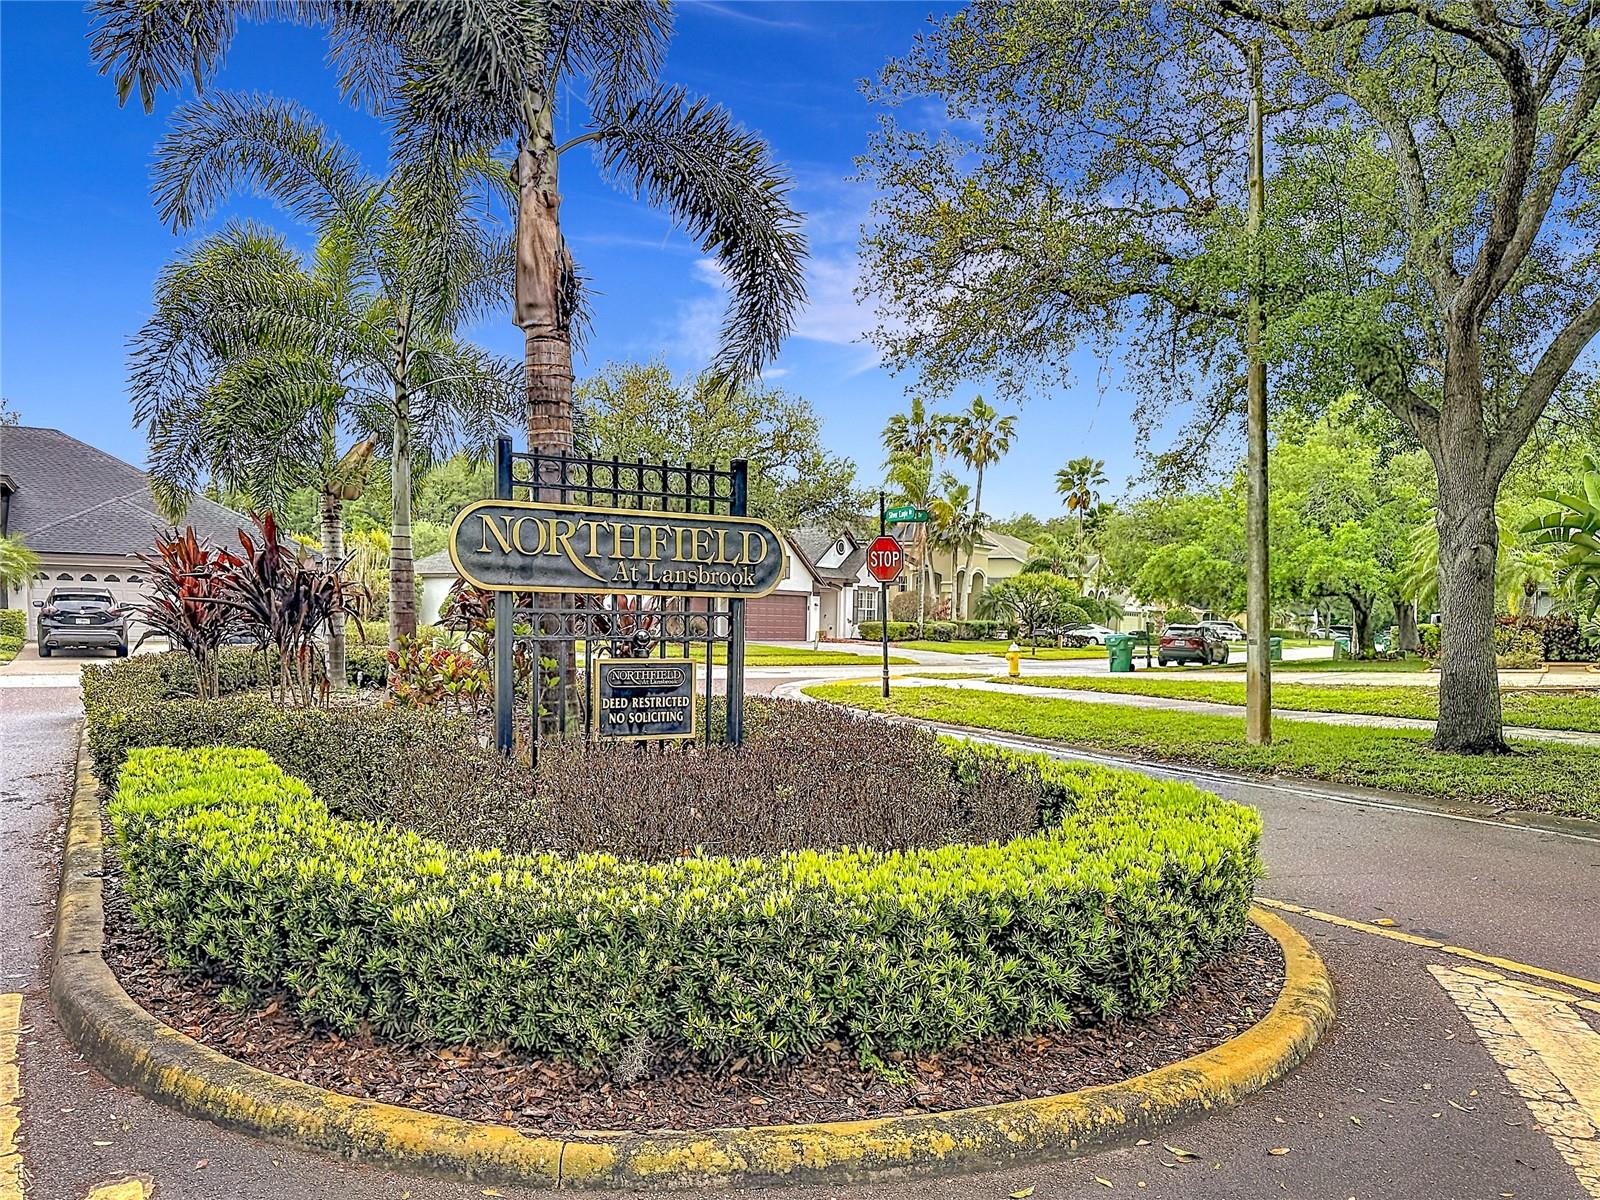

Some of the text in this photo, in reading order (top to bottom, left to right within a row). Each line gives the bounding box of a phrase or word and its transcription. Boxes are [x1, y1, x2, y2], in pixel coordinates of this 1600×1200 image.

[476, 514, 769, 582] NORTHFIELD
[870, 551, 899, 566] STOP
[611, 561, 755, 586] At Lansbrook
[612, 671, 681, 685] NORTHFIELD
[602, 697, 689, 709] DEED RESTRICTED
[609, 711, 683, 723] NO SOLICITING
